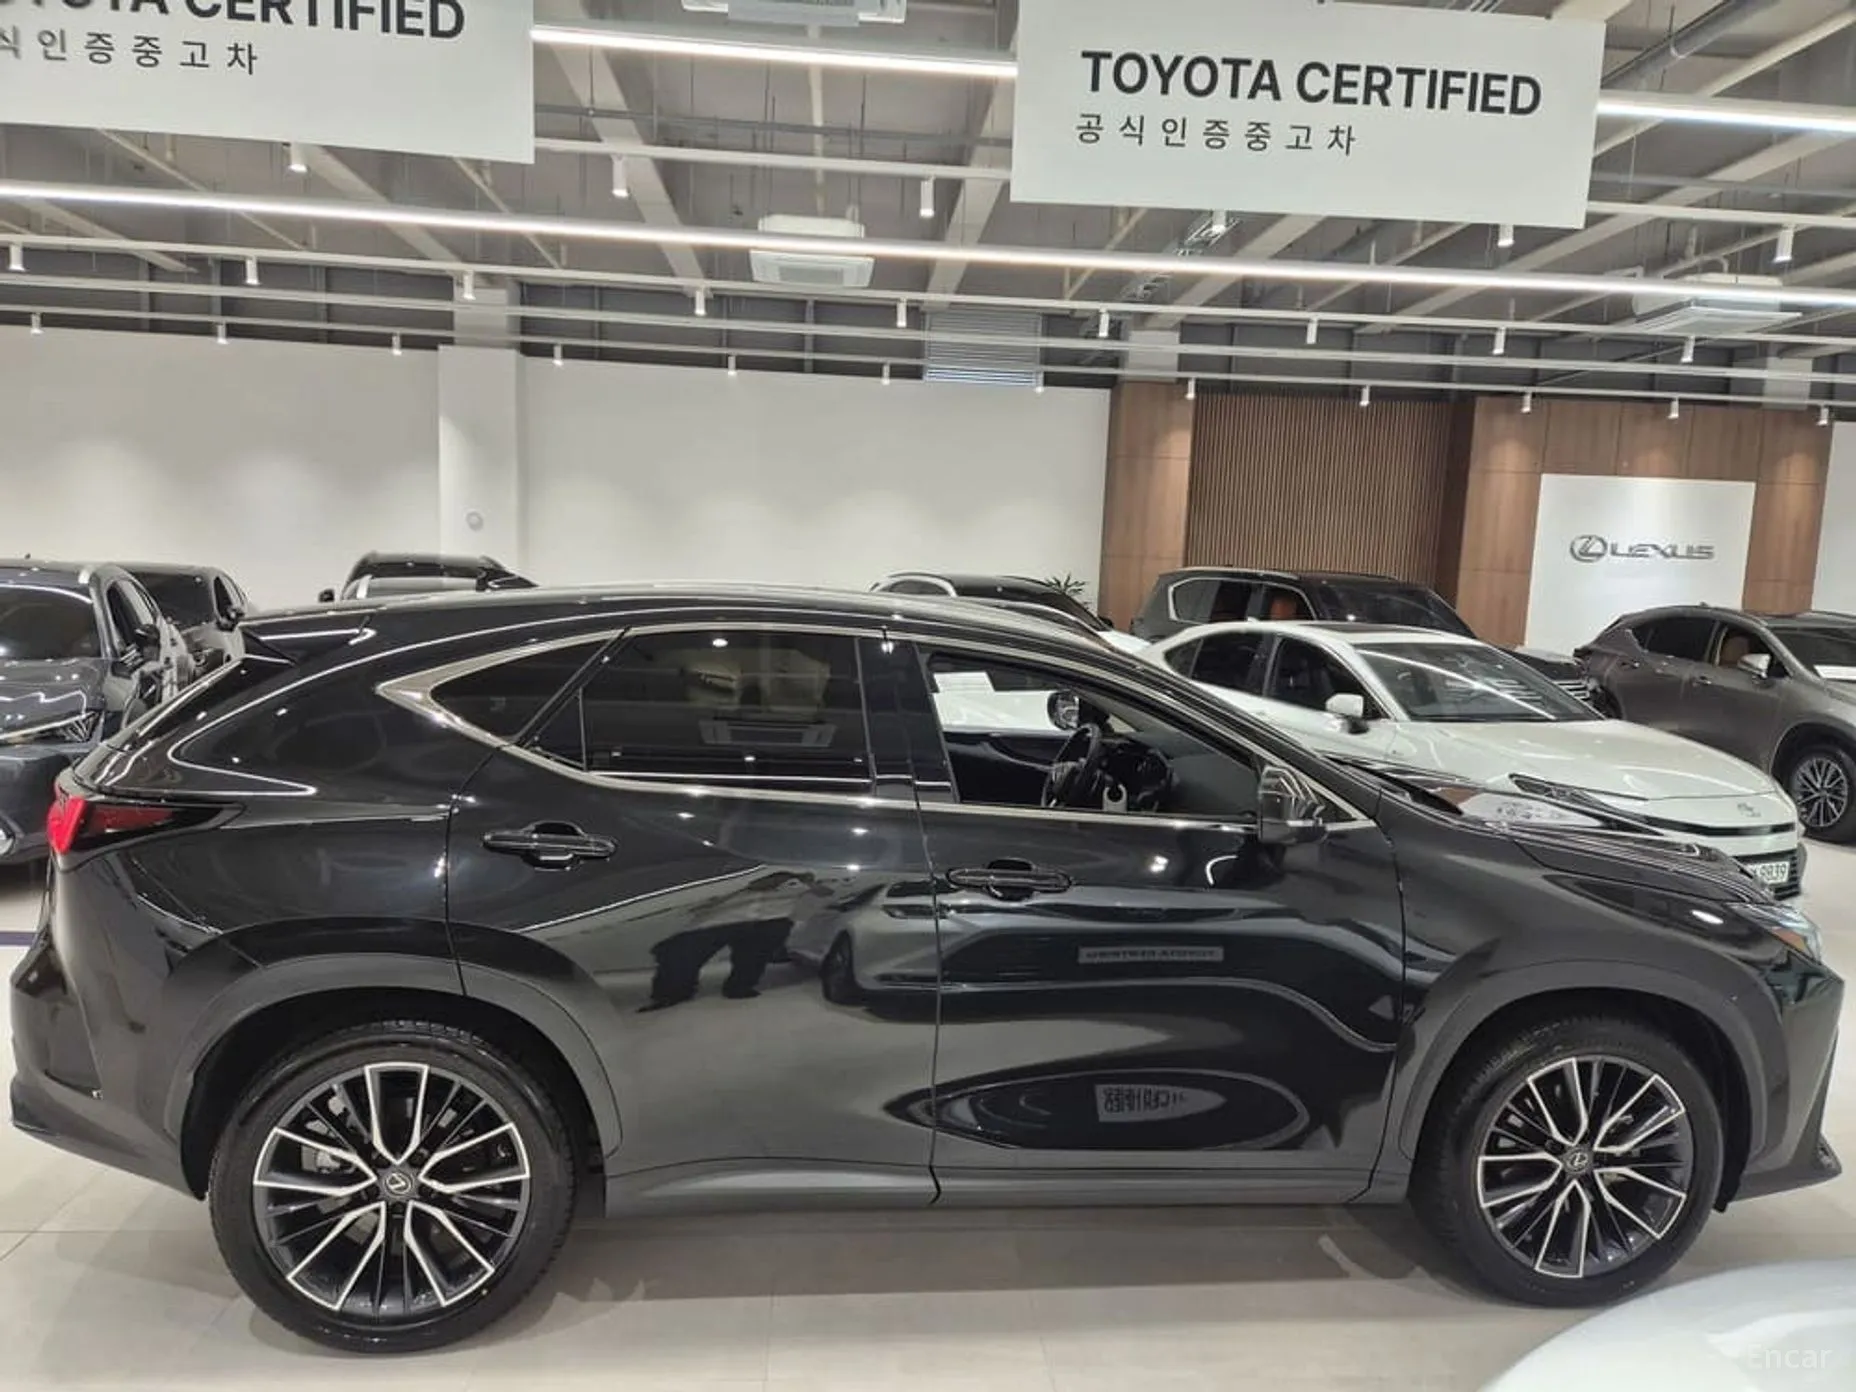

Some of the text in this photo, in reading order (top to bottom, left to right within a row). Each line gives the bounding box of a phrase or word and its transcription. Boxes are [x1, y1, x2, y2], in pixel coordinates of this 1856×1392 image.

[1081, 50, 1542, 116] TOYOTA CERTIFIED
[1610, 543, 1715, 560] LEXUS
